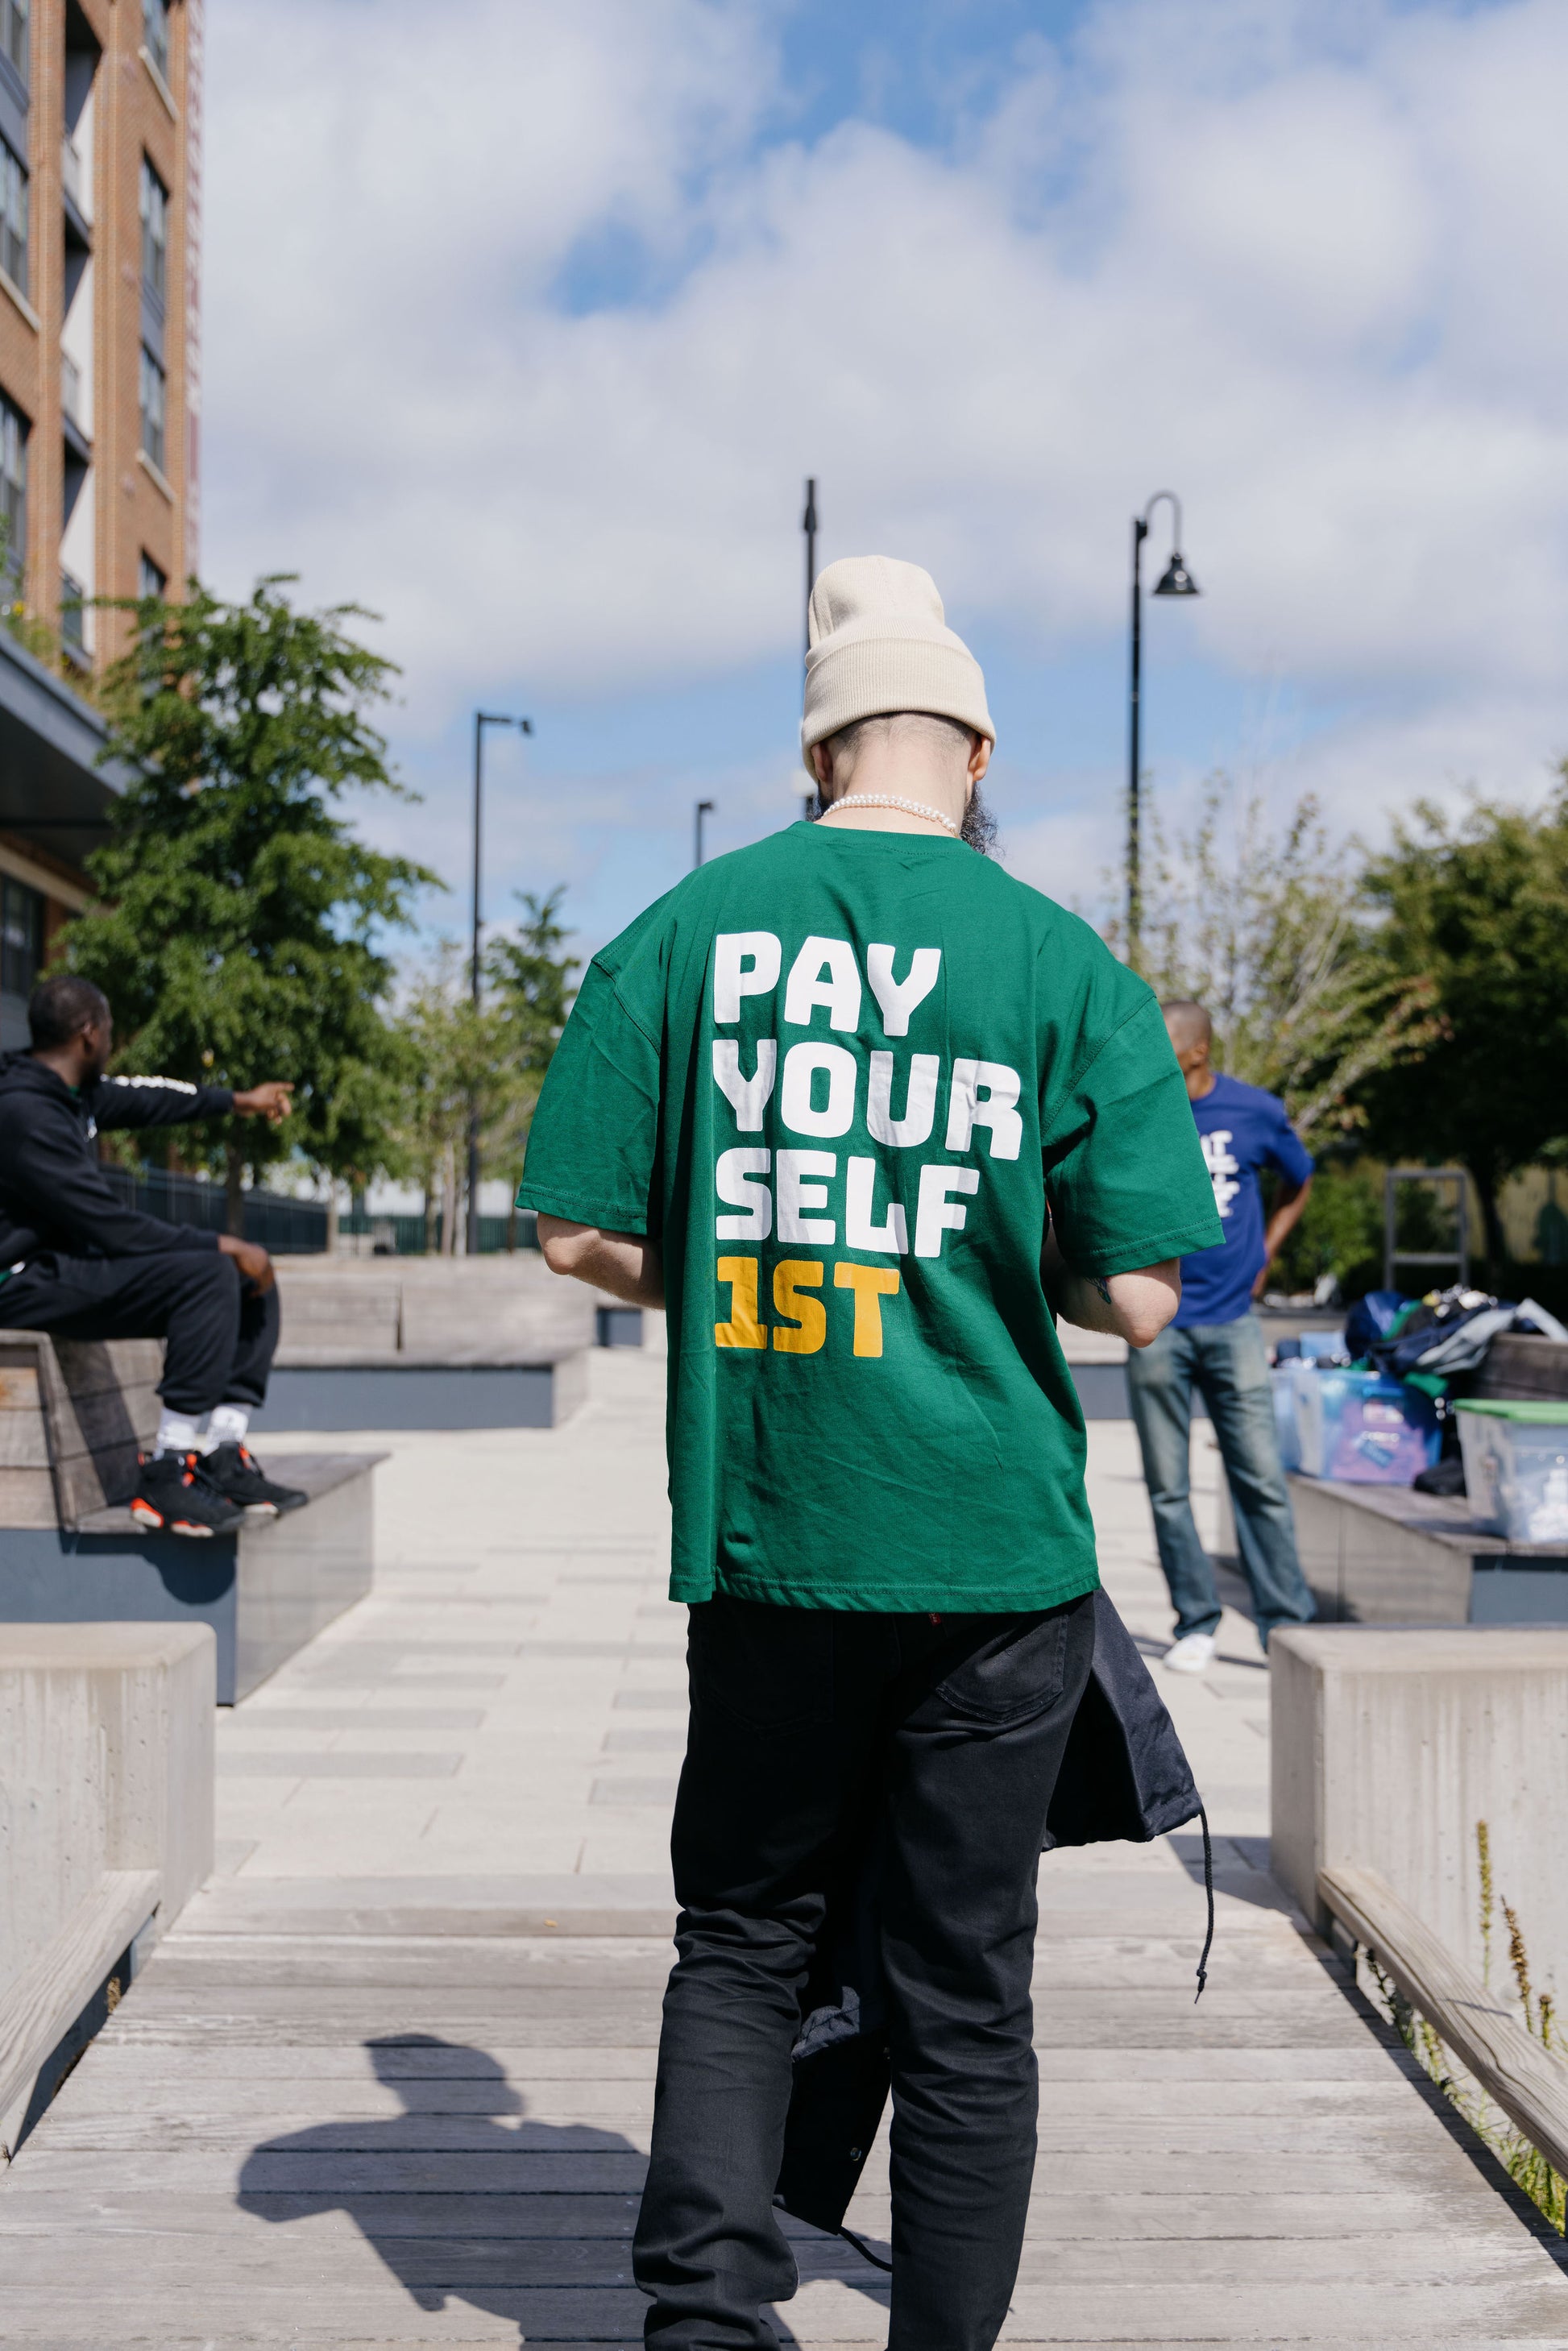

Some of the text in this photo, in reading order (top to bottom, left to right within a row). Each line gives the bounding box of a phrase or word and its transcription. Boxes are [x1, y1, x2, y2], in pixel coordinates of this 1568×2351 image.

[714, 931, 941, 1036] PAY
[712, 1039, 1023, 1160] YOUR
[716, 1148, 980, 1258] SELF
[715, 1257, 900, 1358] 1ST
